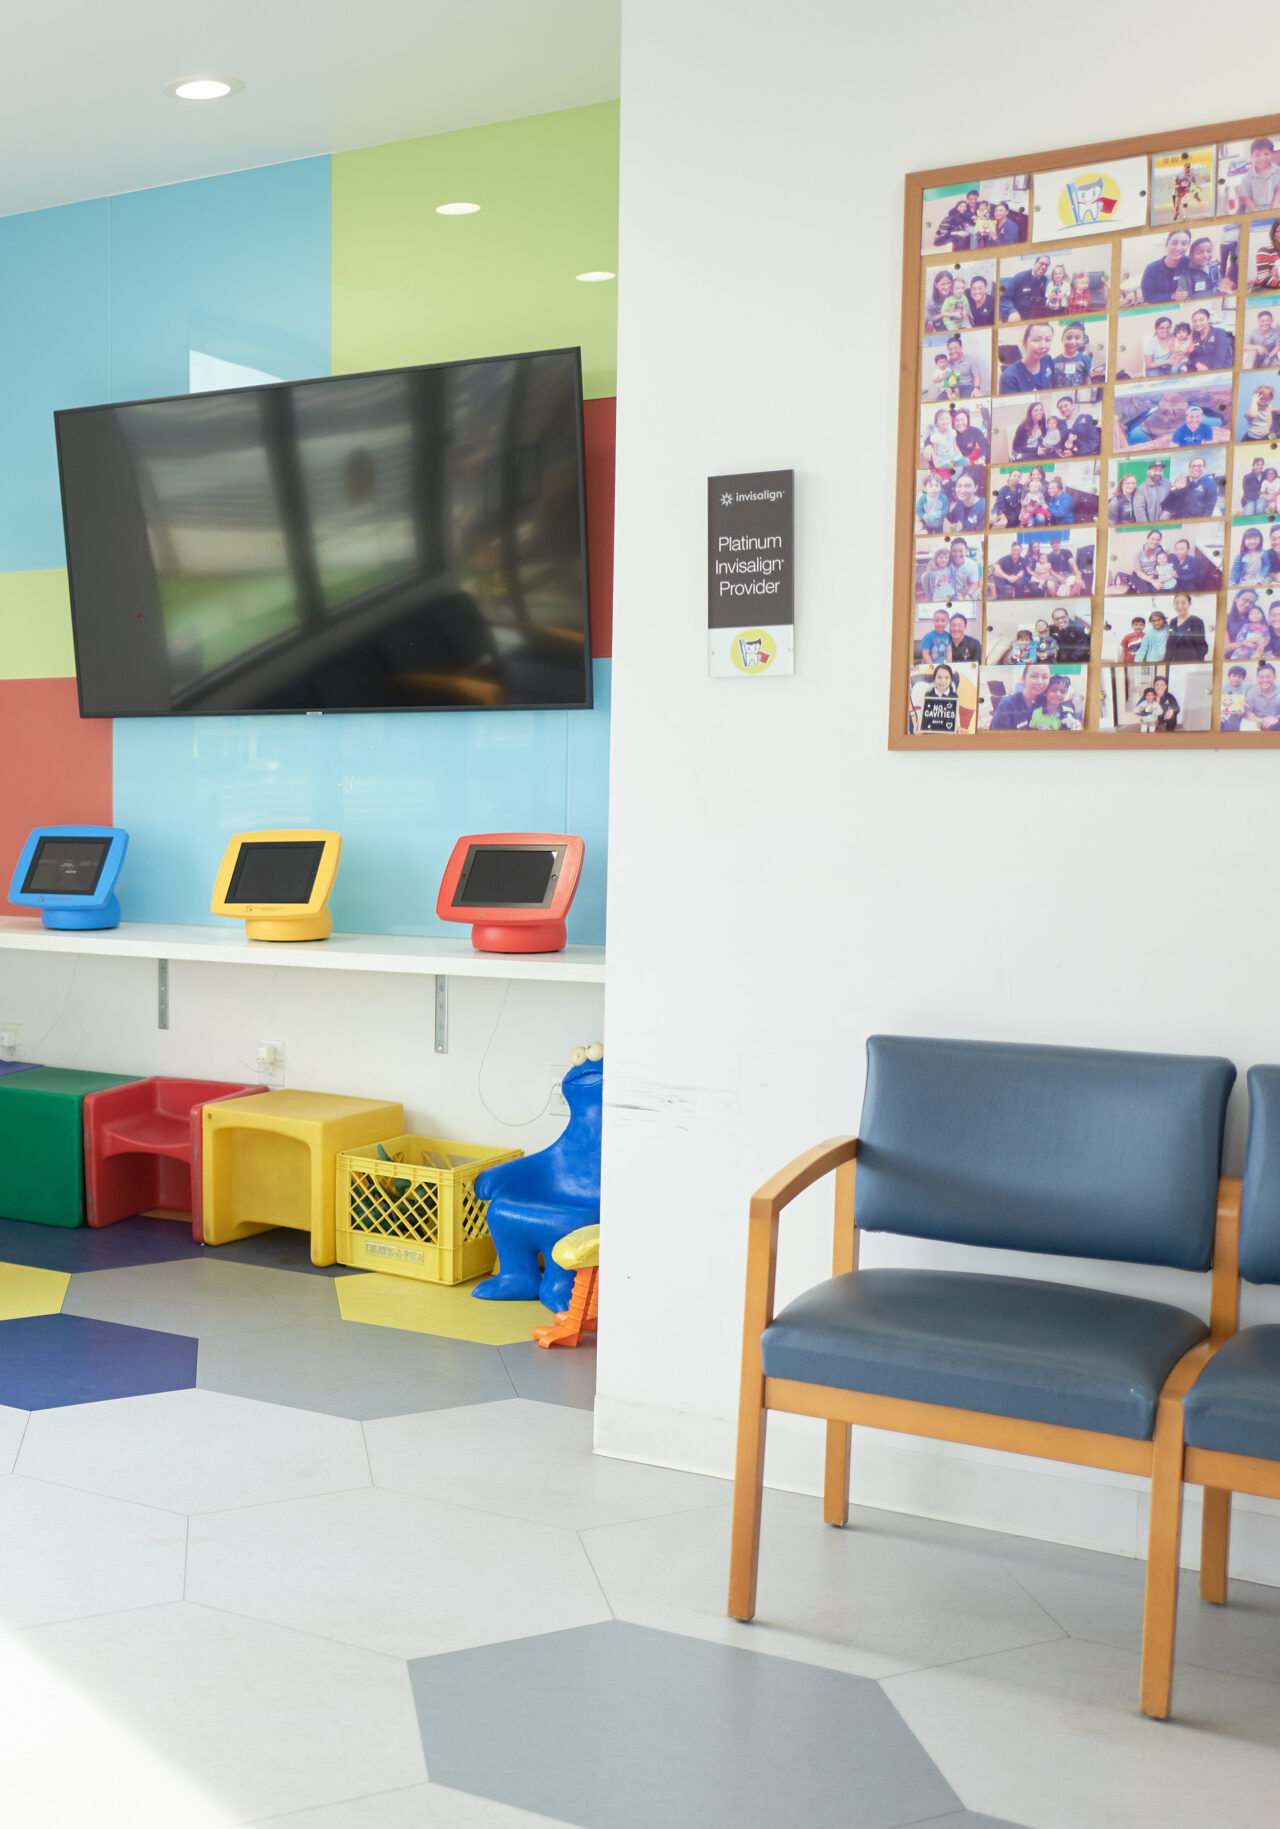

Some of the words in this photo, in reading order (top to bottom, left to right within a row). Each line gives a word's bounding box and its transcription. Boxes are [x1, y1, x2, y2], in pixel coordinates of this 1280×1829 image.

[735, 489, 783, 502] invisalign
[718, 534, 782, 552] Platinum
[715, 557, 783, 575] Invisalign
[719, 579, 781, 597] Provider
[924, 710, 955, 719] CAVITIES
